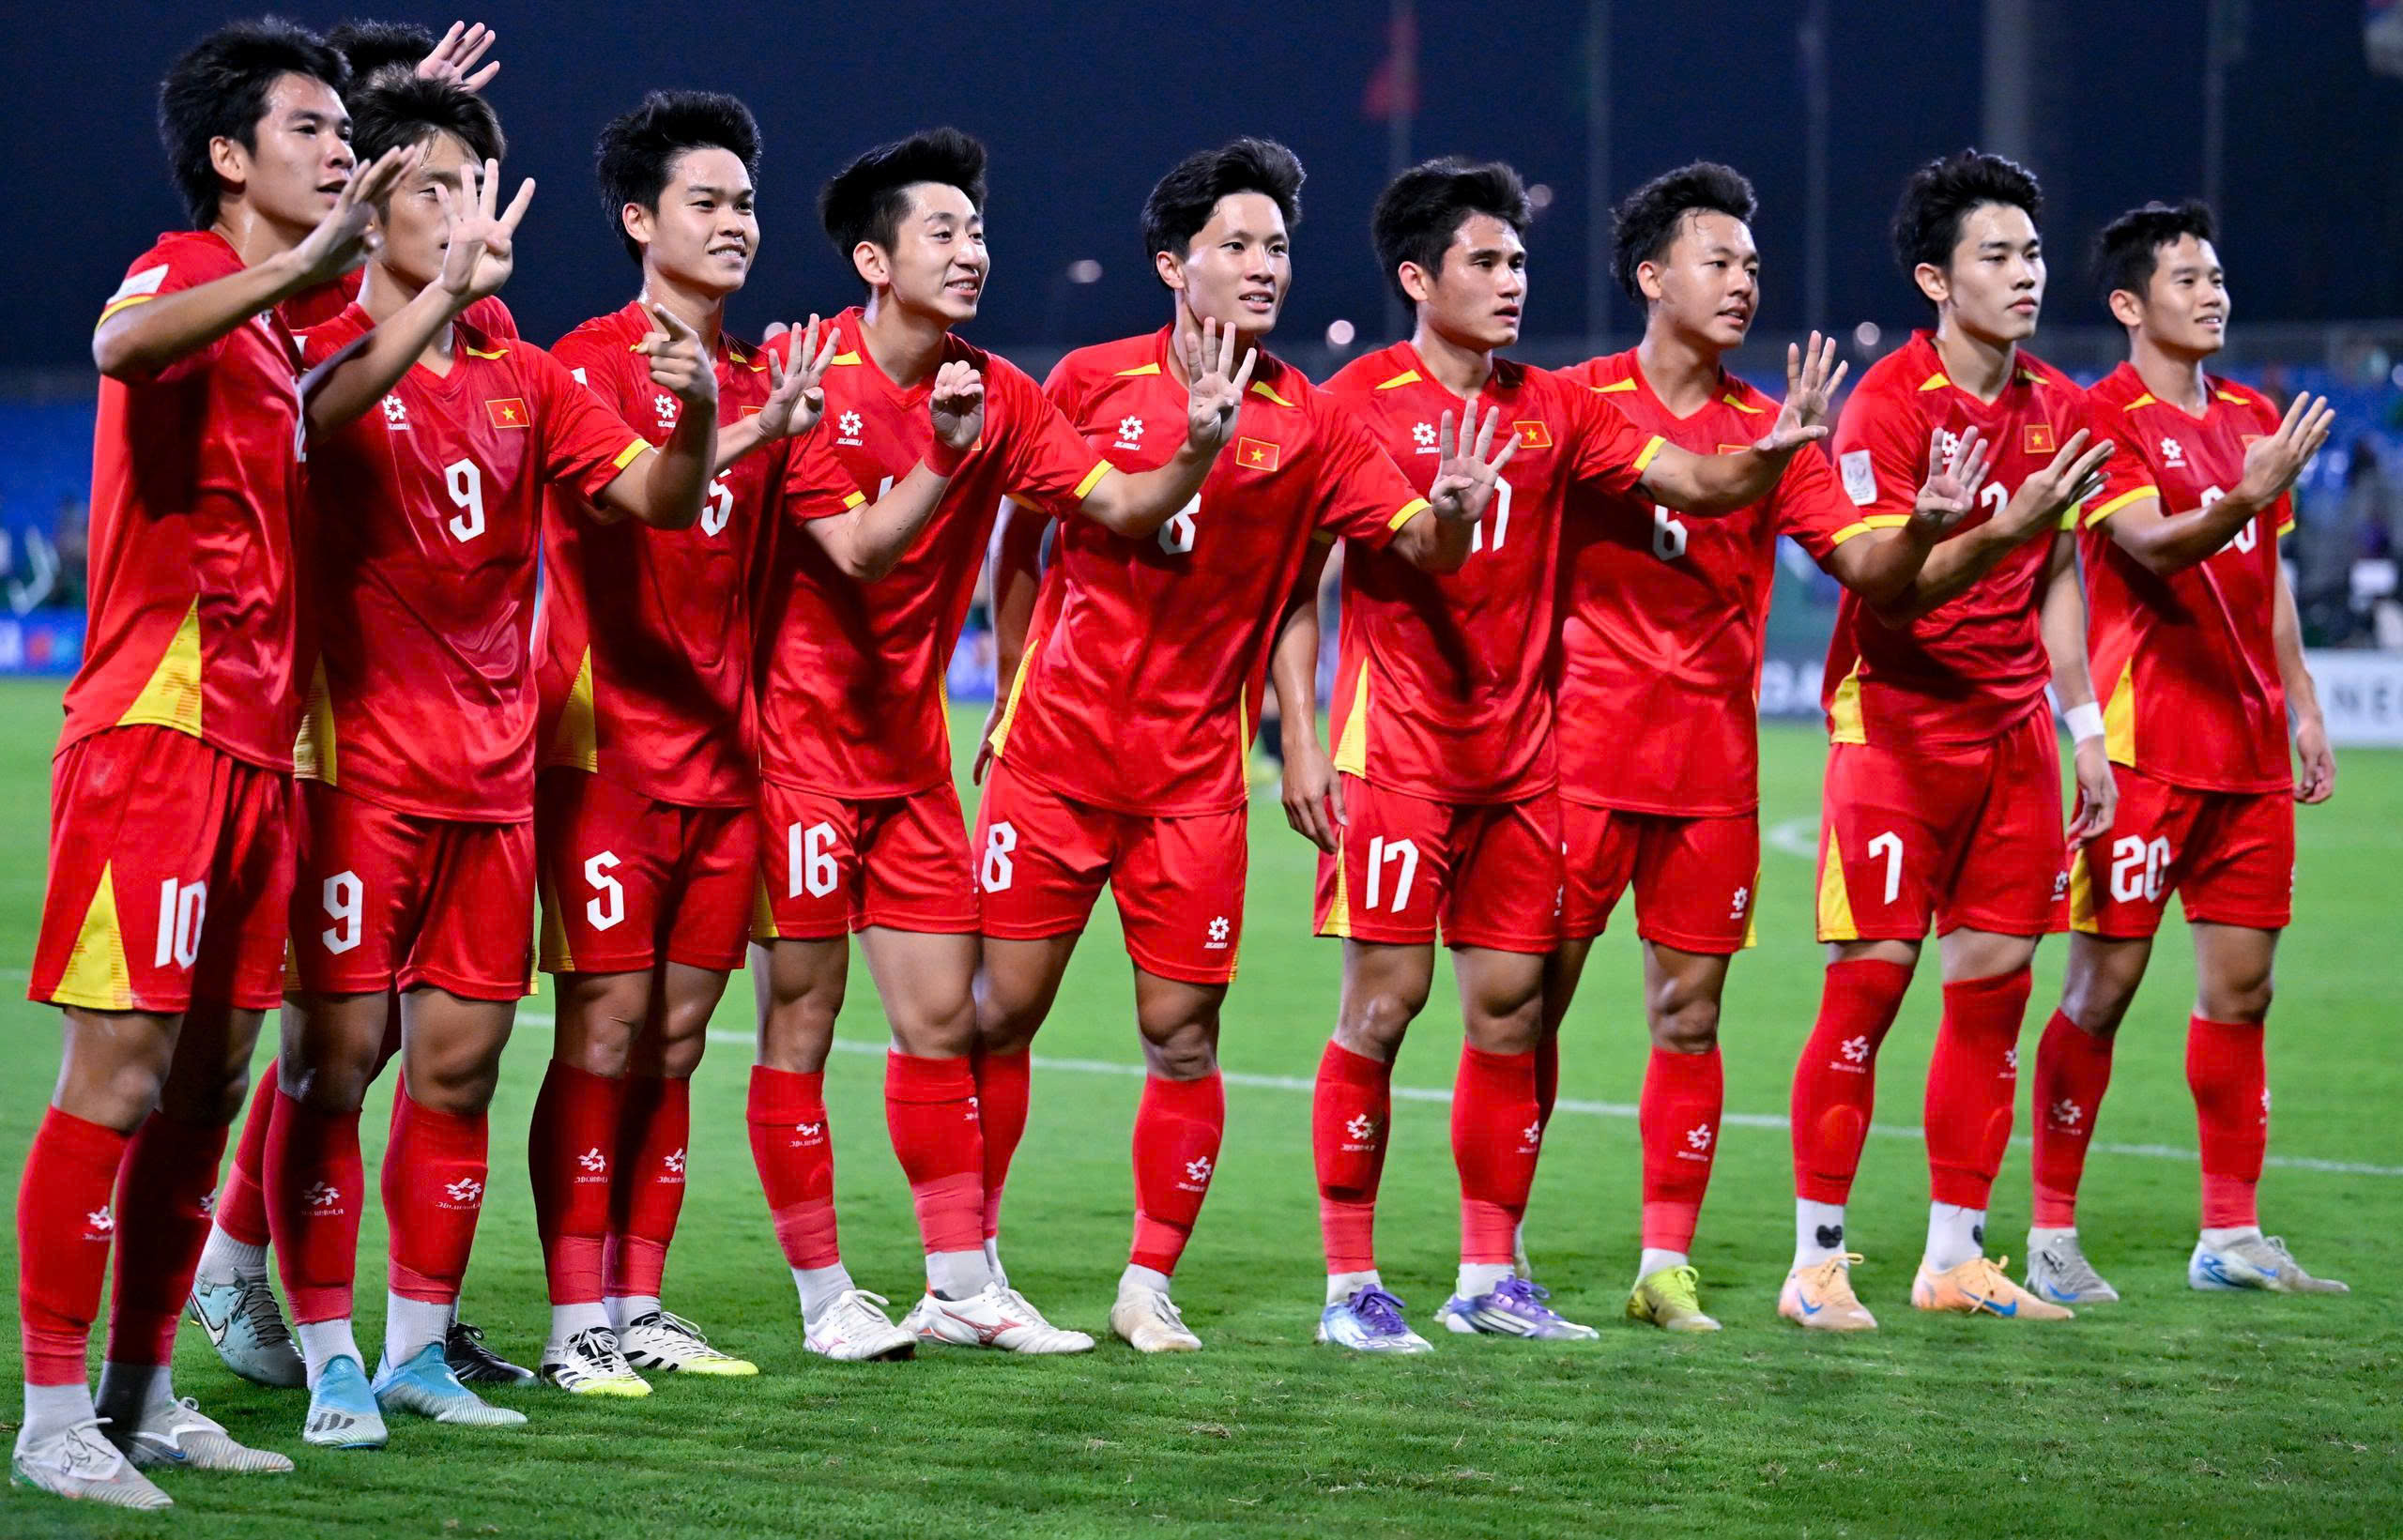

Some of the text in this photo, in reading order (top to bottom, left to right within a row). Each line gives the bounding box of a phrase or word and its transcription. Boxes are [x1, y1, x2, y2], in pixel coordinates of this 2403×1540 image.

[443, 457, 485, 542] 9
[700, 468, 734, 538] 5
[1653, 504, 1689, 561] 6
[584, 849, 625, 932] 5
[788, 820, 838, 899] 16
[980, 820, 1018, 893] 8
[1365, 835, 1419, 913] 17
[1867, 831, 1904, 905] 7
[2109, 834, 2171, 904] 20
[154, 877, 207, 970] 10
[322, 870, 364, 955] 9
